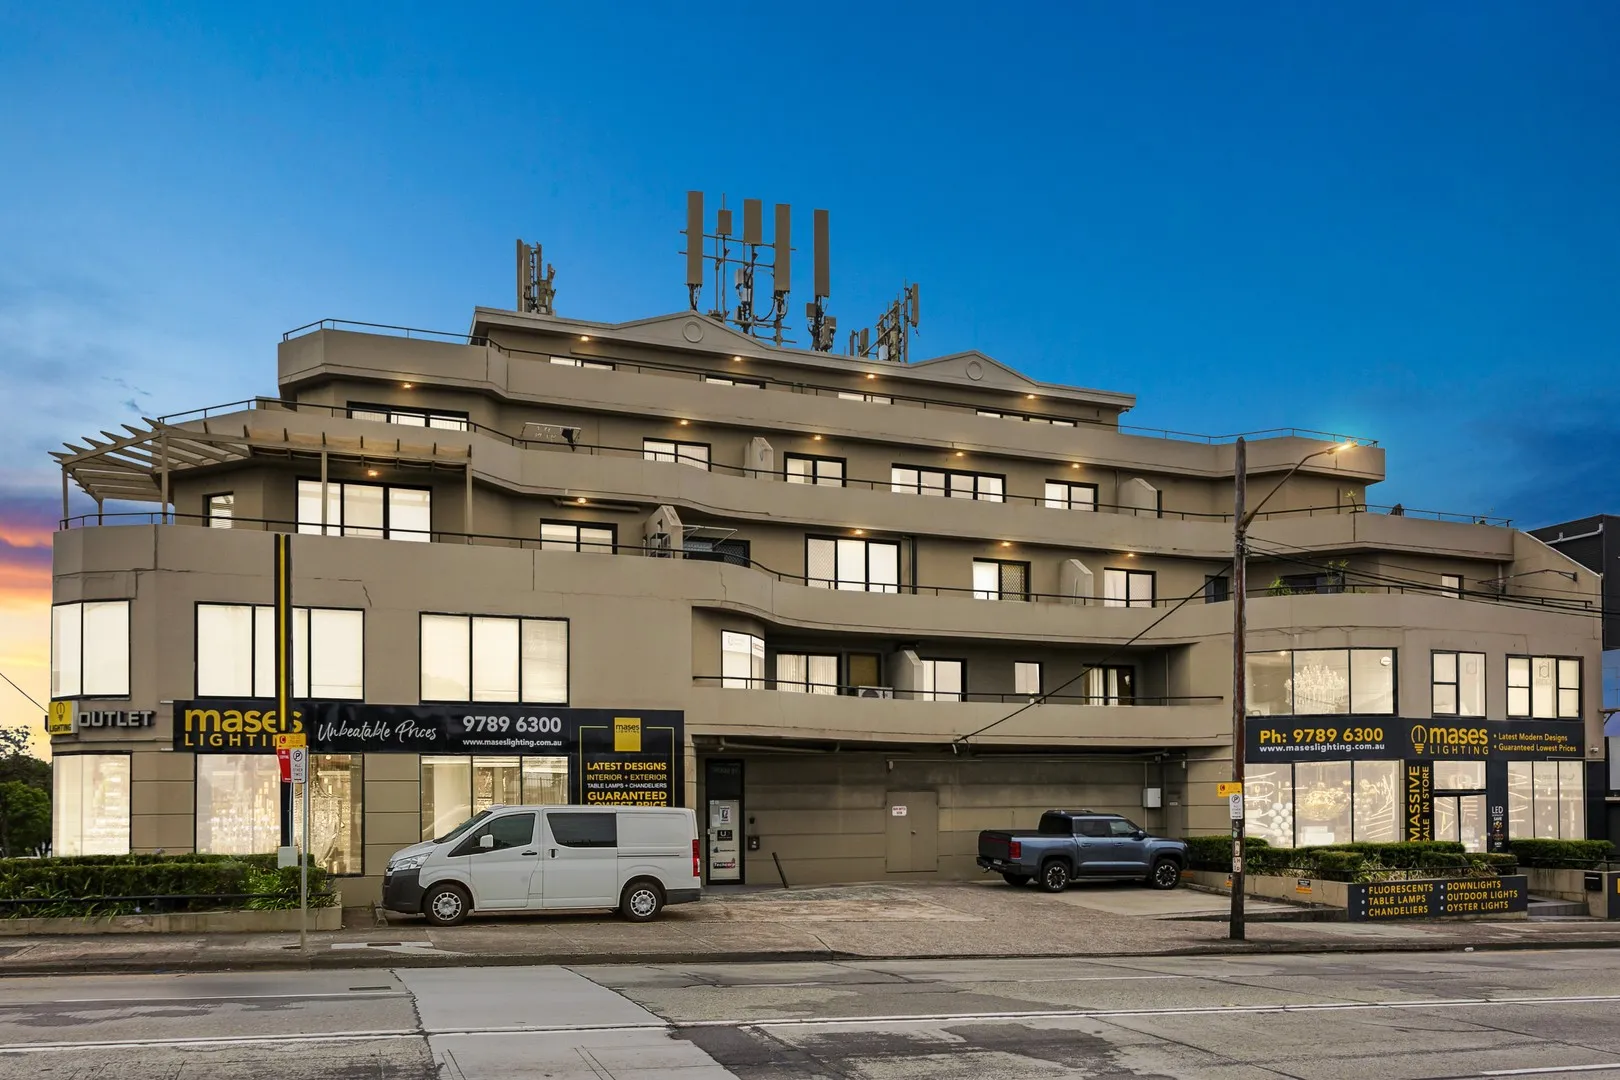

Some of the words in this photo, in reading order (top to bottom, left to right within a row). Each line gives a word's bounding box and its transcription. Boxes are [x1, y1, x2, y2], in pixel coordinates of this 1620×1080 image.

[79, 710, 153, 727] OUTLET
[463, 715, 510, 732] 9789
[515, 716, 562, 733] 6300
[318, 720, 391, 742] Unbeatable
[395, 719, 437, 743] Prices
[1260, 729, 1287, 744] Ph:
[1293, 728, 1337, 743] 9789
[1343, 727, 1383, 742] 6300
[1429, 726, 1489, 745] mases
[185, 733, 277, 747] LIGHTI
[462, 738, 562, 748] www.maseslighting.com.au
[1498, 733, 1518, 741] Latest
[1519, 733, 1543, 741] Modern
[1544, 734, 1568, 743] Designs
[1259, 742, 1385, 753] www.maseslighting.com.au
[1429, 745, 1489, 755] LIGHTING
[1498, 743, 1535, 751] Guaranteed
[1536, 744, 1558, 752] Lowest
[1558, 744, 1577, 752] Prices
[587, 762, 622, 770] LATEST
[624, 762, 667, 771] DESIGNS
[1422, 766, 1430, 799] STORE
[587, 791, 667, 800] GUARANTEED
[1408, 765, 1420, 842] MASSIVE
[1422, 802, 1430, 813] IN
[1491, 805, 1504, 814] LED
[1368, 883, 1434, 895] FLUORESCENTS
[1447, 880, 1501, 891] DOWNLIGHTS
[1368, 895, 1395, 906] TABLE
[1398, 894, 1426, 904] LAMPS
[1447, 891, 1487, 901] OUTDOOR
[1490, 889, 1518, 899] LIGHTS
[1368, 905, 1428, 917] CHANDELIERS
[1447, 902, 1478, 912] OYSTER
[1481, 900, 1509, 910] LIGHTS
